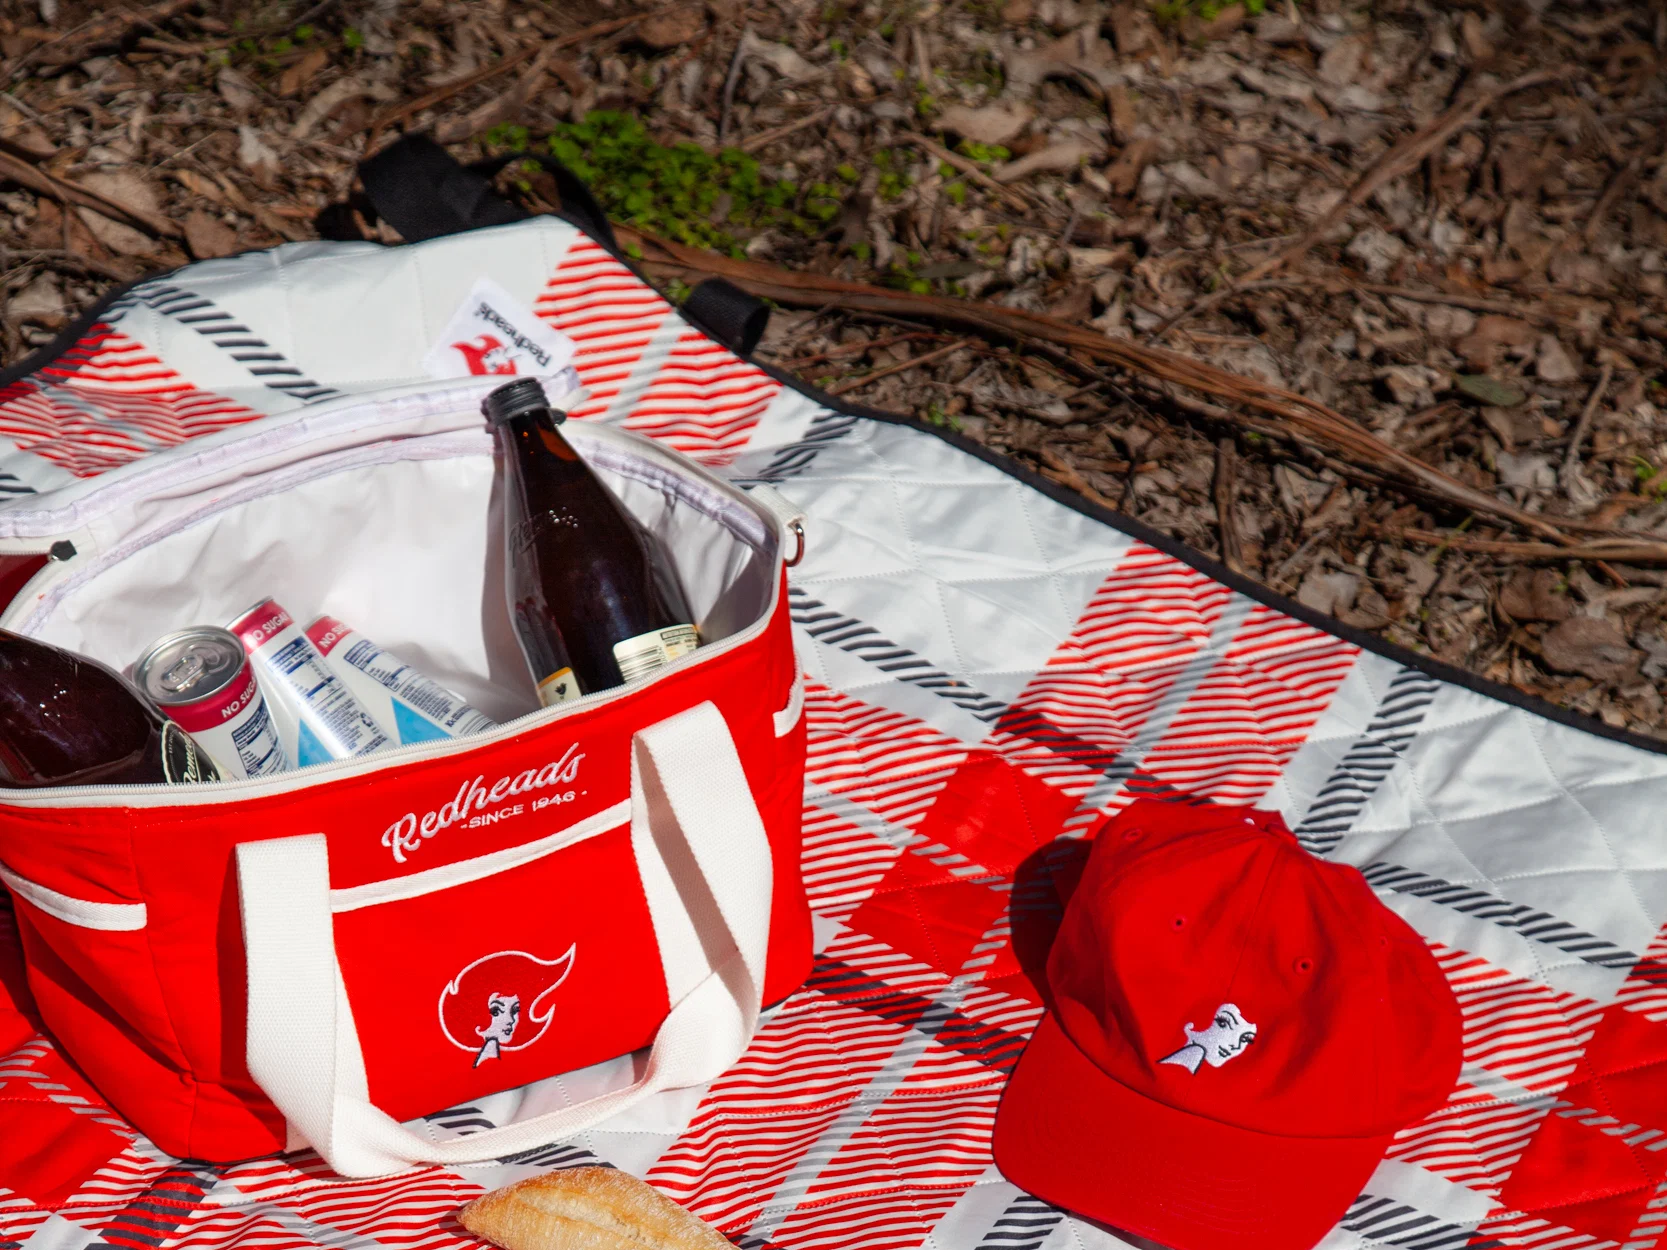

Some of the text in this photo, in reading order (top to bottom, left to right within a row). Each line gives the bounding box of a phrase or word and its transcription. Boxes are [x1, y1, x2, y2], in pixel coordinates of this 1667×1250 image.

[244, 630, 264, 649] O
[318, 632, 336, 649] NO
[221, 701, 240, 718] NO
[381, 741, 586, 863] Redheads
[531, 790, 576, 812] 1946
